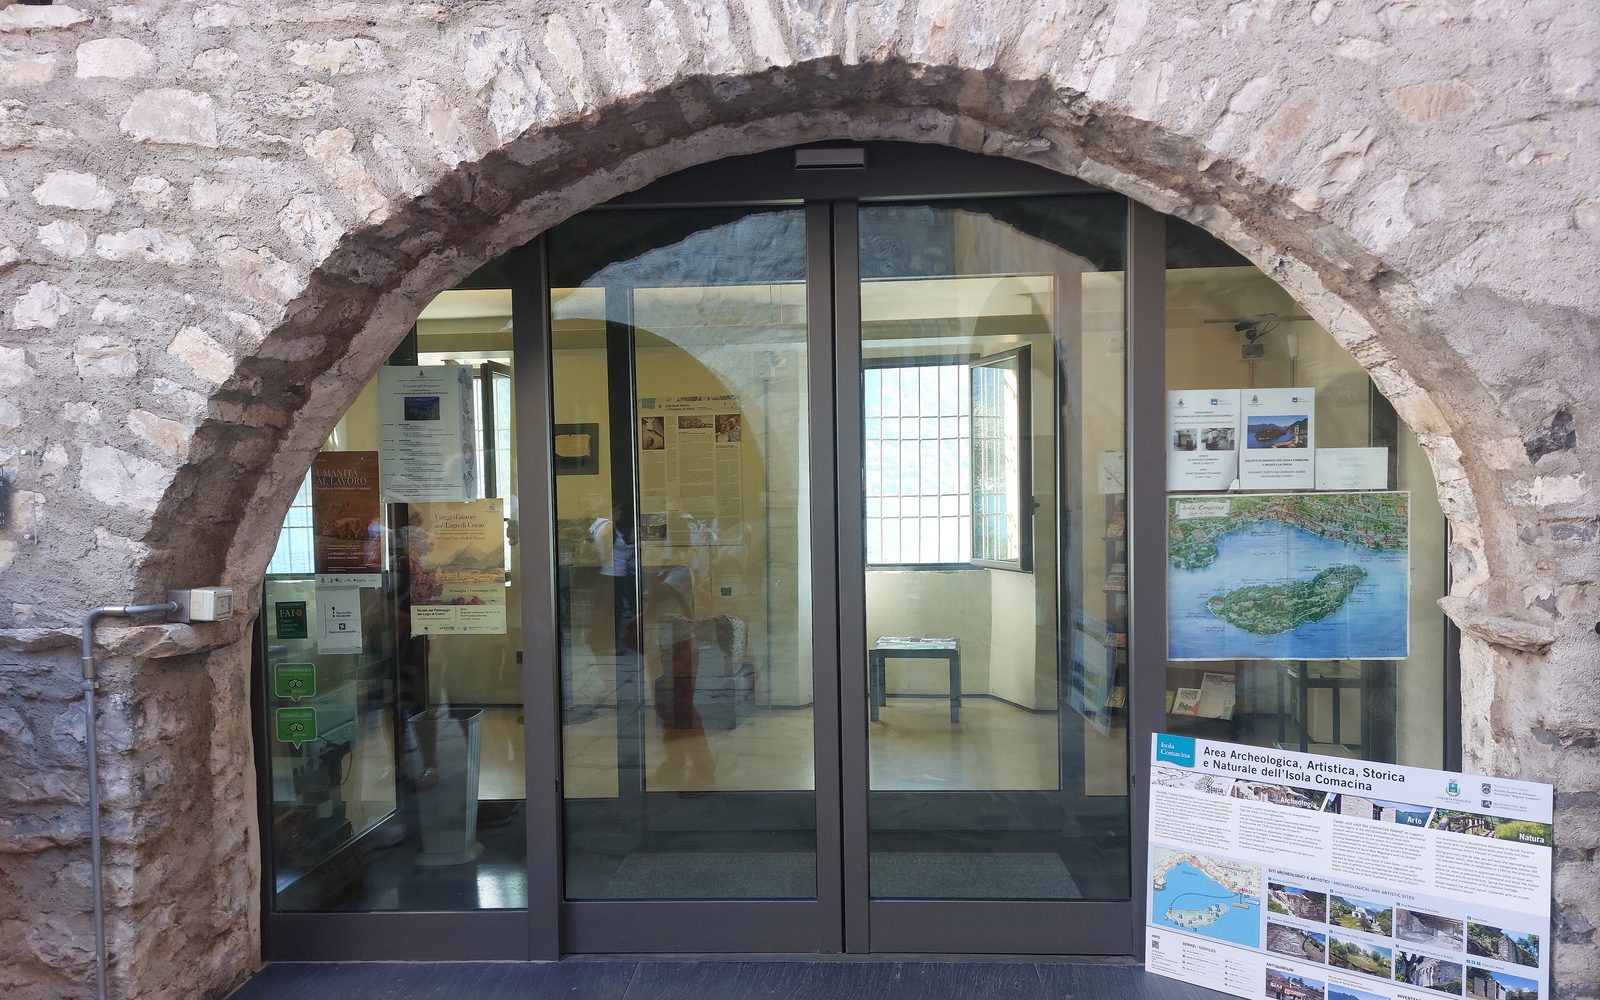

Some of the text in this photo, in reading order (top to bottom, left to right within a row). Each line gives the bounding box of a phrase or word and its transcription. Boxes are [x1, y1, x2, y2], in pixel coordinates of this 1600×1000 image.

[280, 609, 294, 618] FAI
[1160, 742, 1175, 750] Isola
[1160, 749, 1190, 759] Comacina
[1204, 746, 1405, 782] Area Archeologica, Artistica, Storica
[1213, 760, 1257, 774] Naturale
[1261, 768, 1311, 782] dell'Isola
[1315, 774, 1372, 791] Comacina
[1280, 797, 1317, 808] Archeologia
[1406, 816, 1422, 824] Arte
[1520, 833, 1544, 843] Natura
[1277, 870, 1306, 879] ARCHEOLOGICI
[1333, 881, 1370, 892] ARCHAEOLOGICAL
[1382, 890, 1401, 898] ARTISTIC
